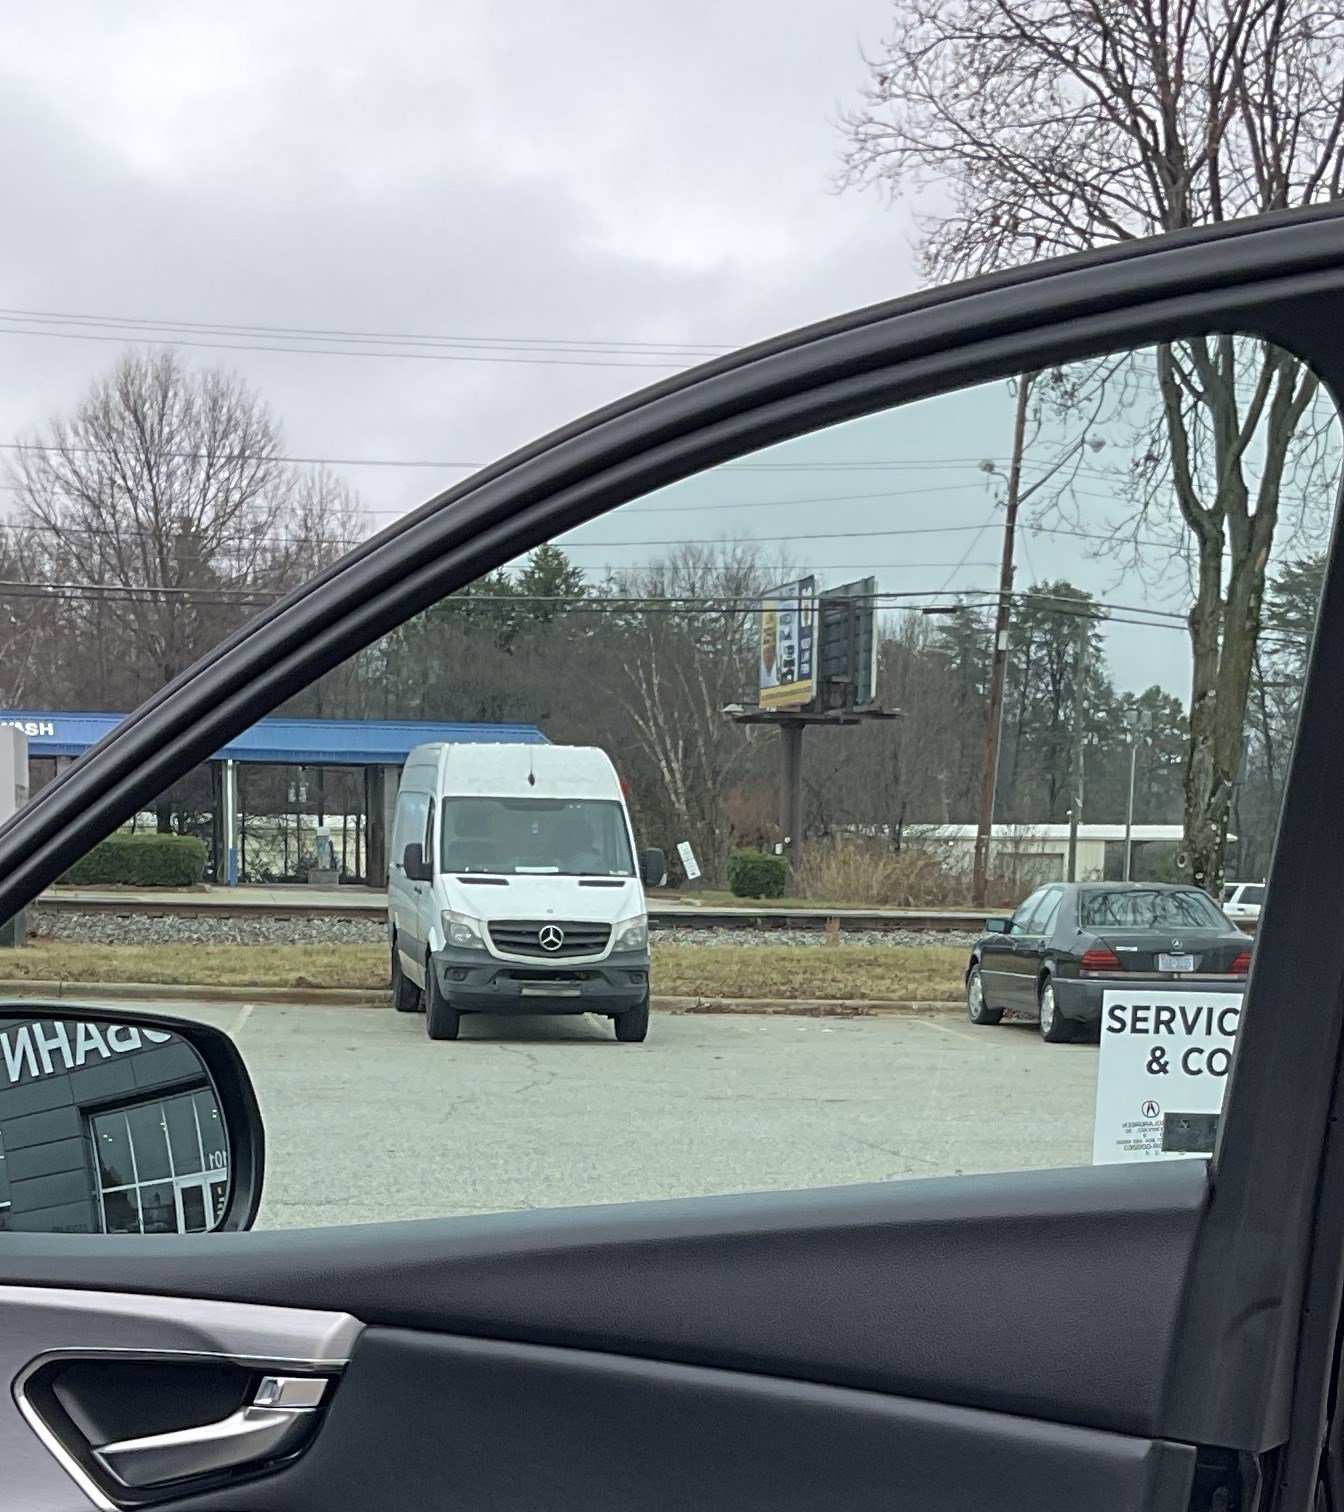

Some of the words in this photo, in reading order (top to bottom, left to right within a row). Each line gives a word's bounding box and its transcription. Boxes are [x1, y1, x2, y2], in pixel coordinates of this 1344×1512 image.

[1106, 1004, 1241, 1037] SERVIC
[1146, 1045, 1170, 1075] &
[1181, 1047, 1232, 1077] CO
